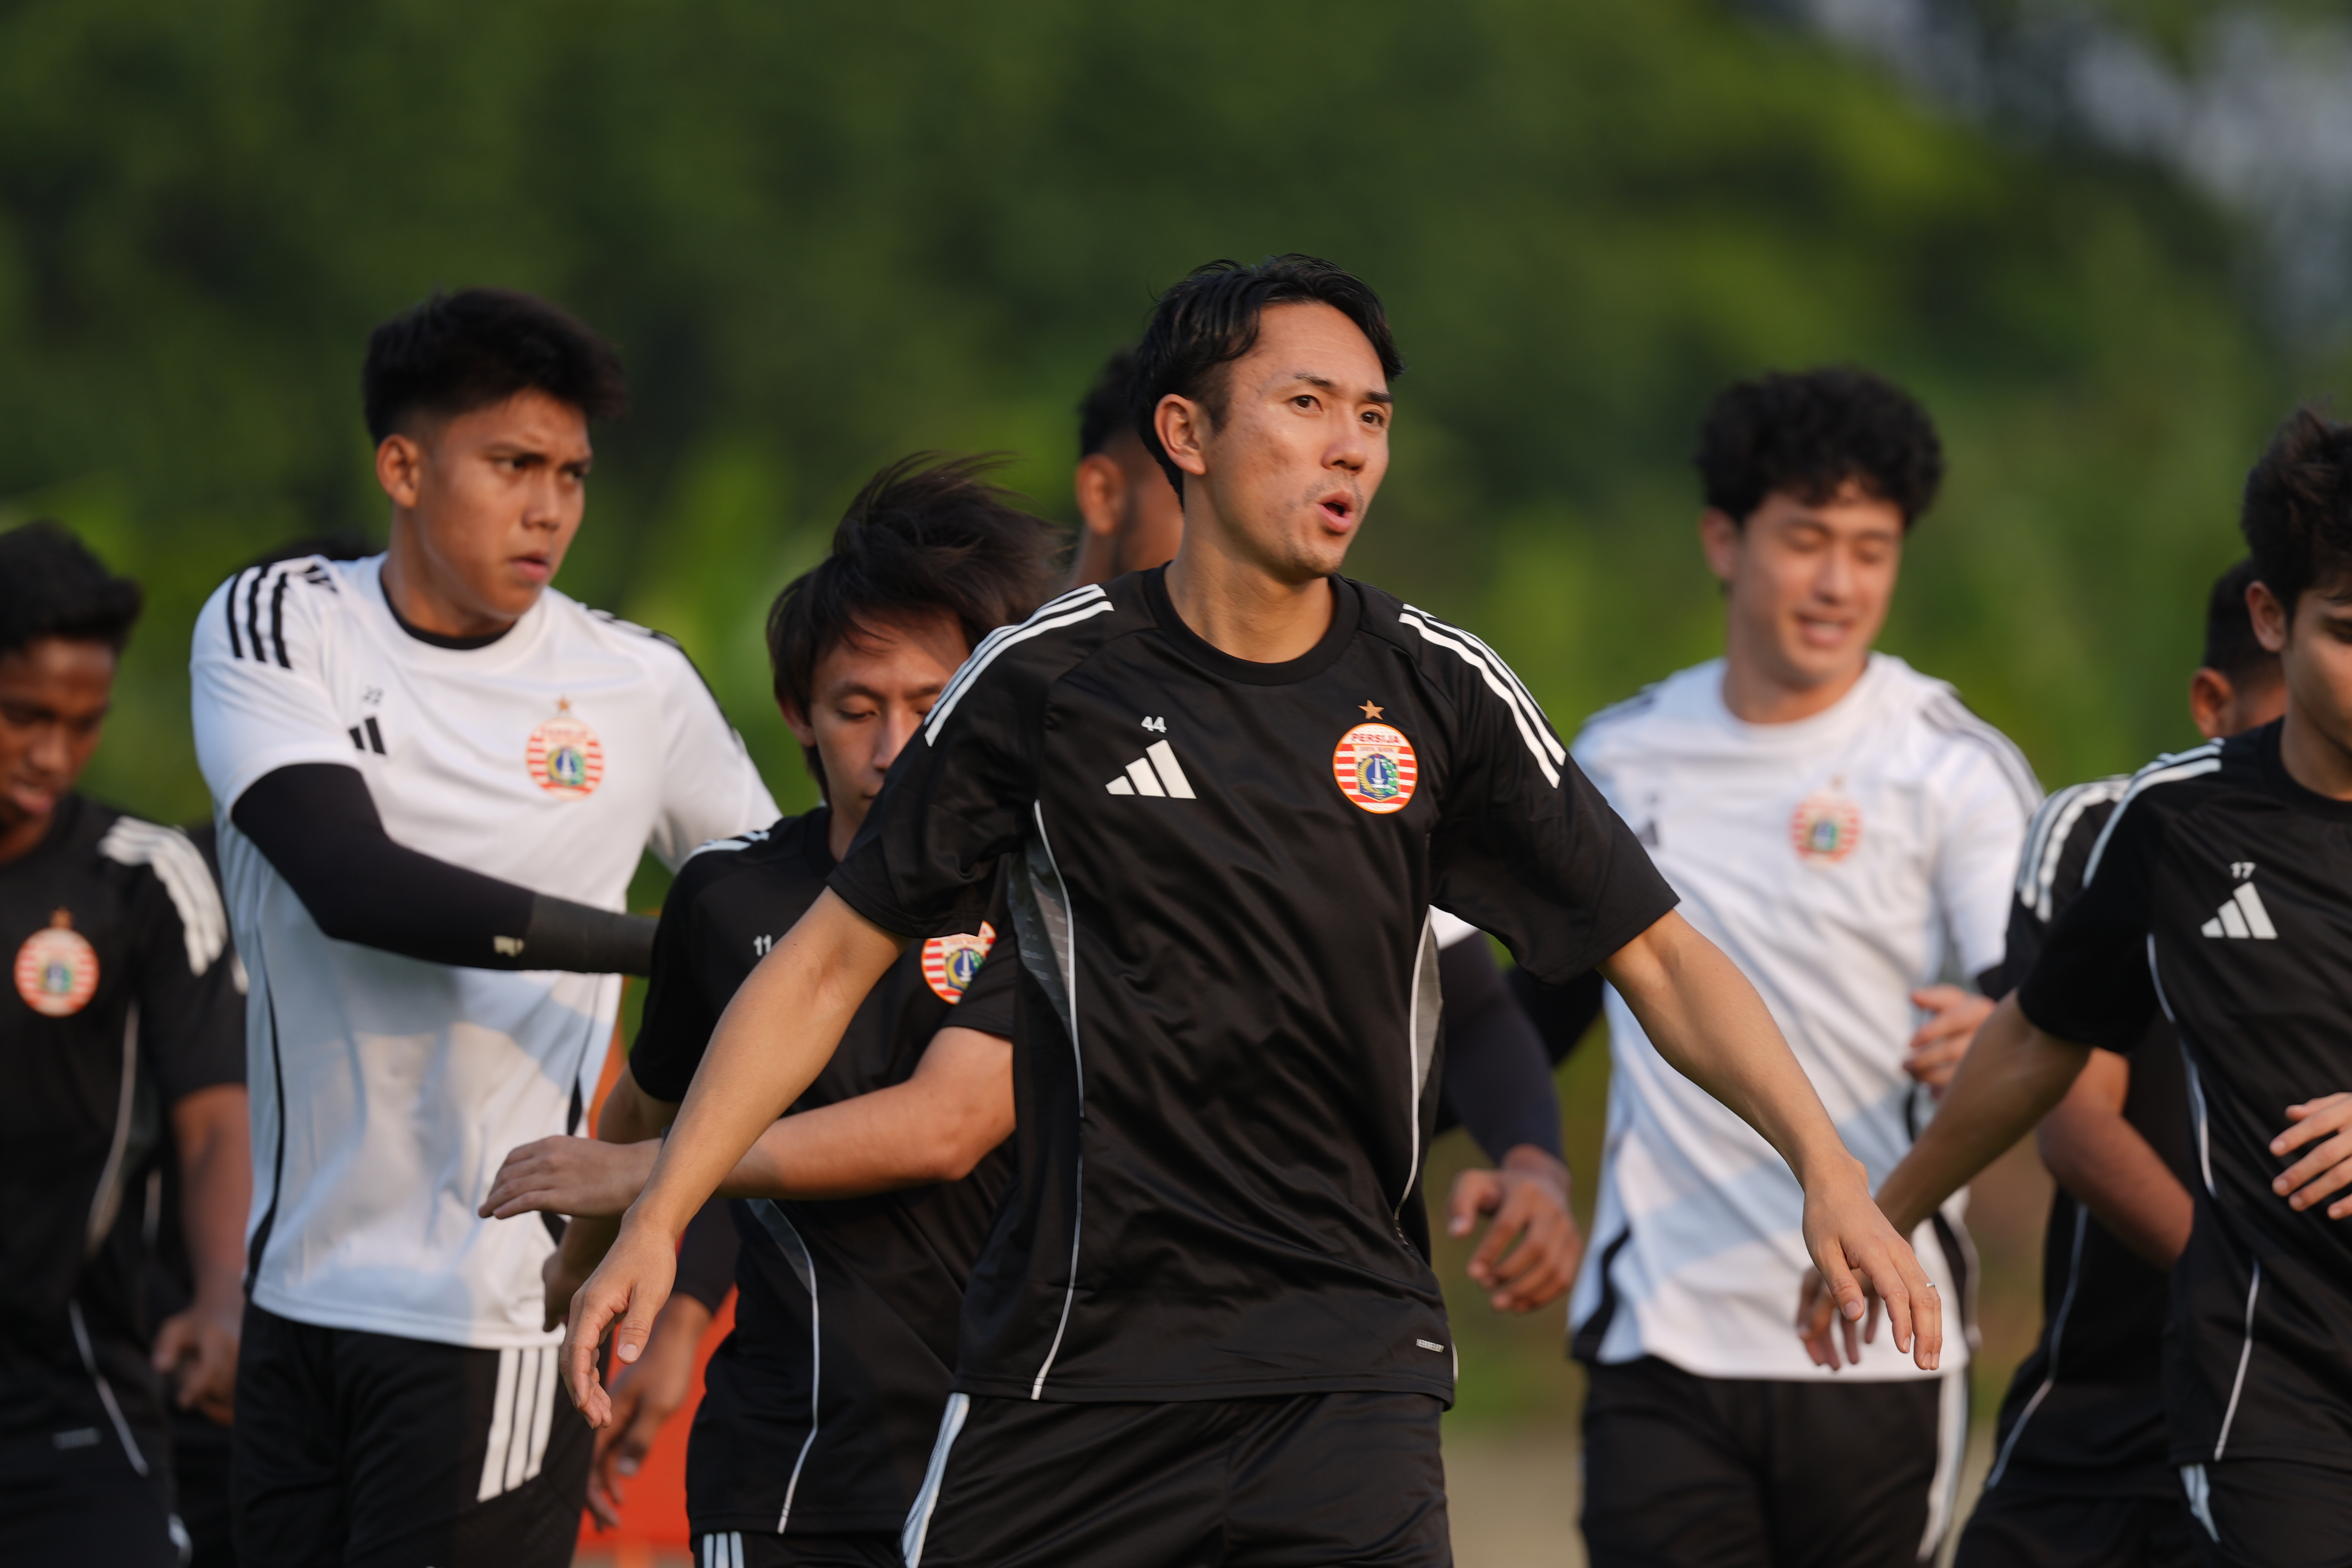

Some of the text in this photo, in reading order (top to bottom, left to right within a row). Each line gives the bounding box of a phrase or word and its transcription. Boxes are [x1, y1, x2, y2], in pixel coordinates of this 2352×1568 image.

[1141, 716, 1167, 733] 44
[1352, 733, 1400, 743] PERSIJA
[2230, 861, 2257, 879] 17
[752, 934, 772, 956] 11
